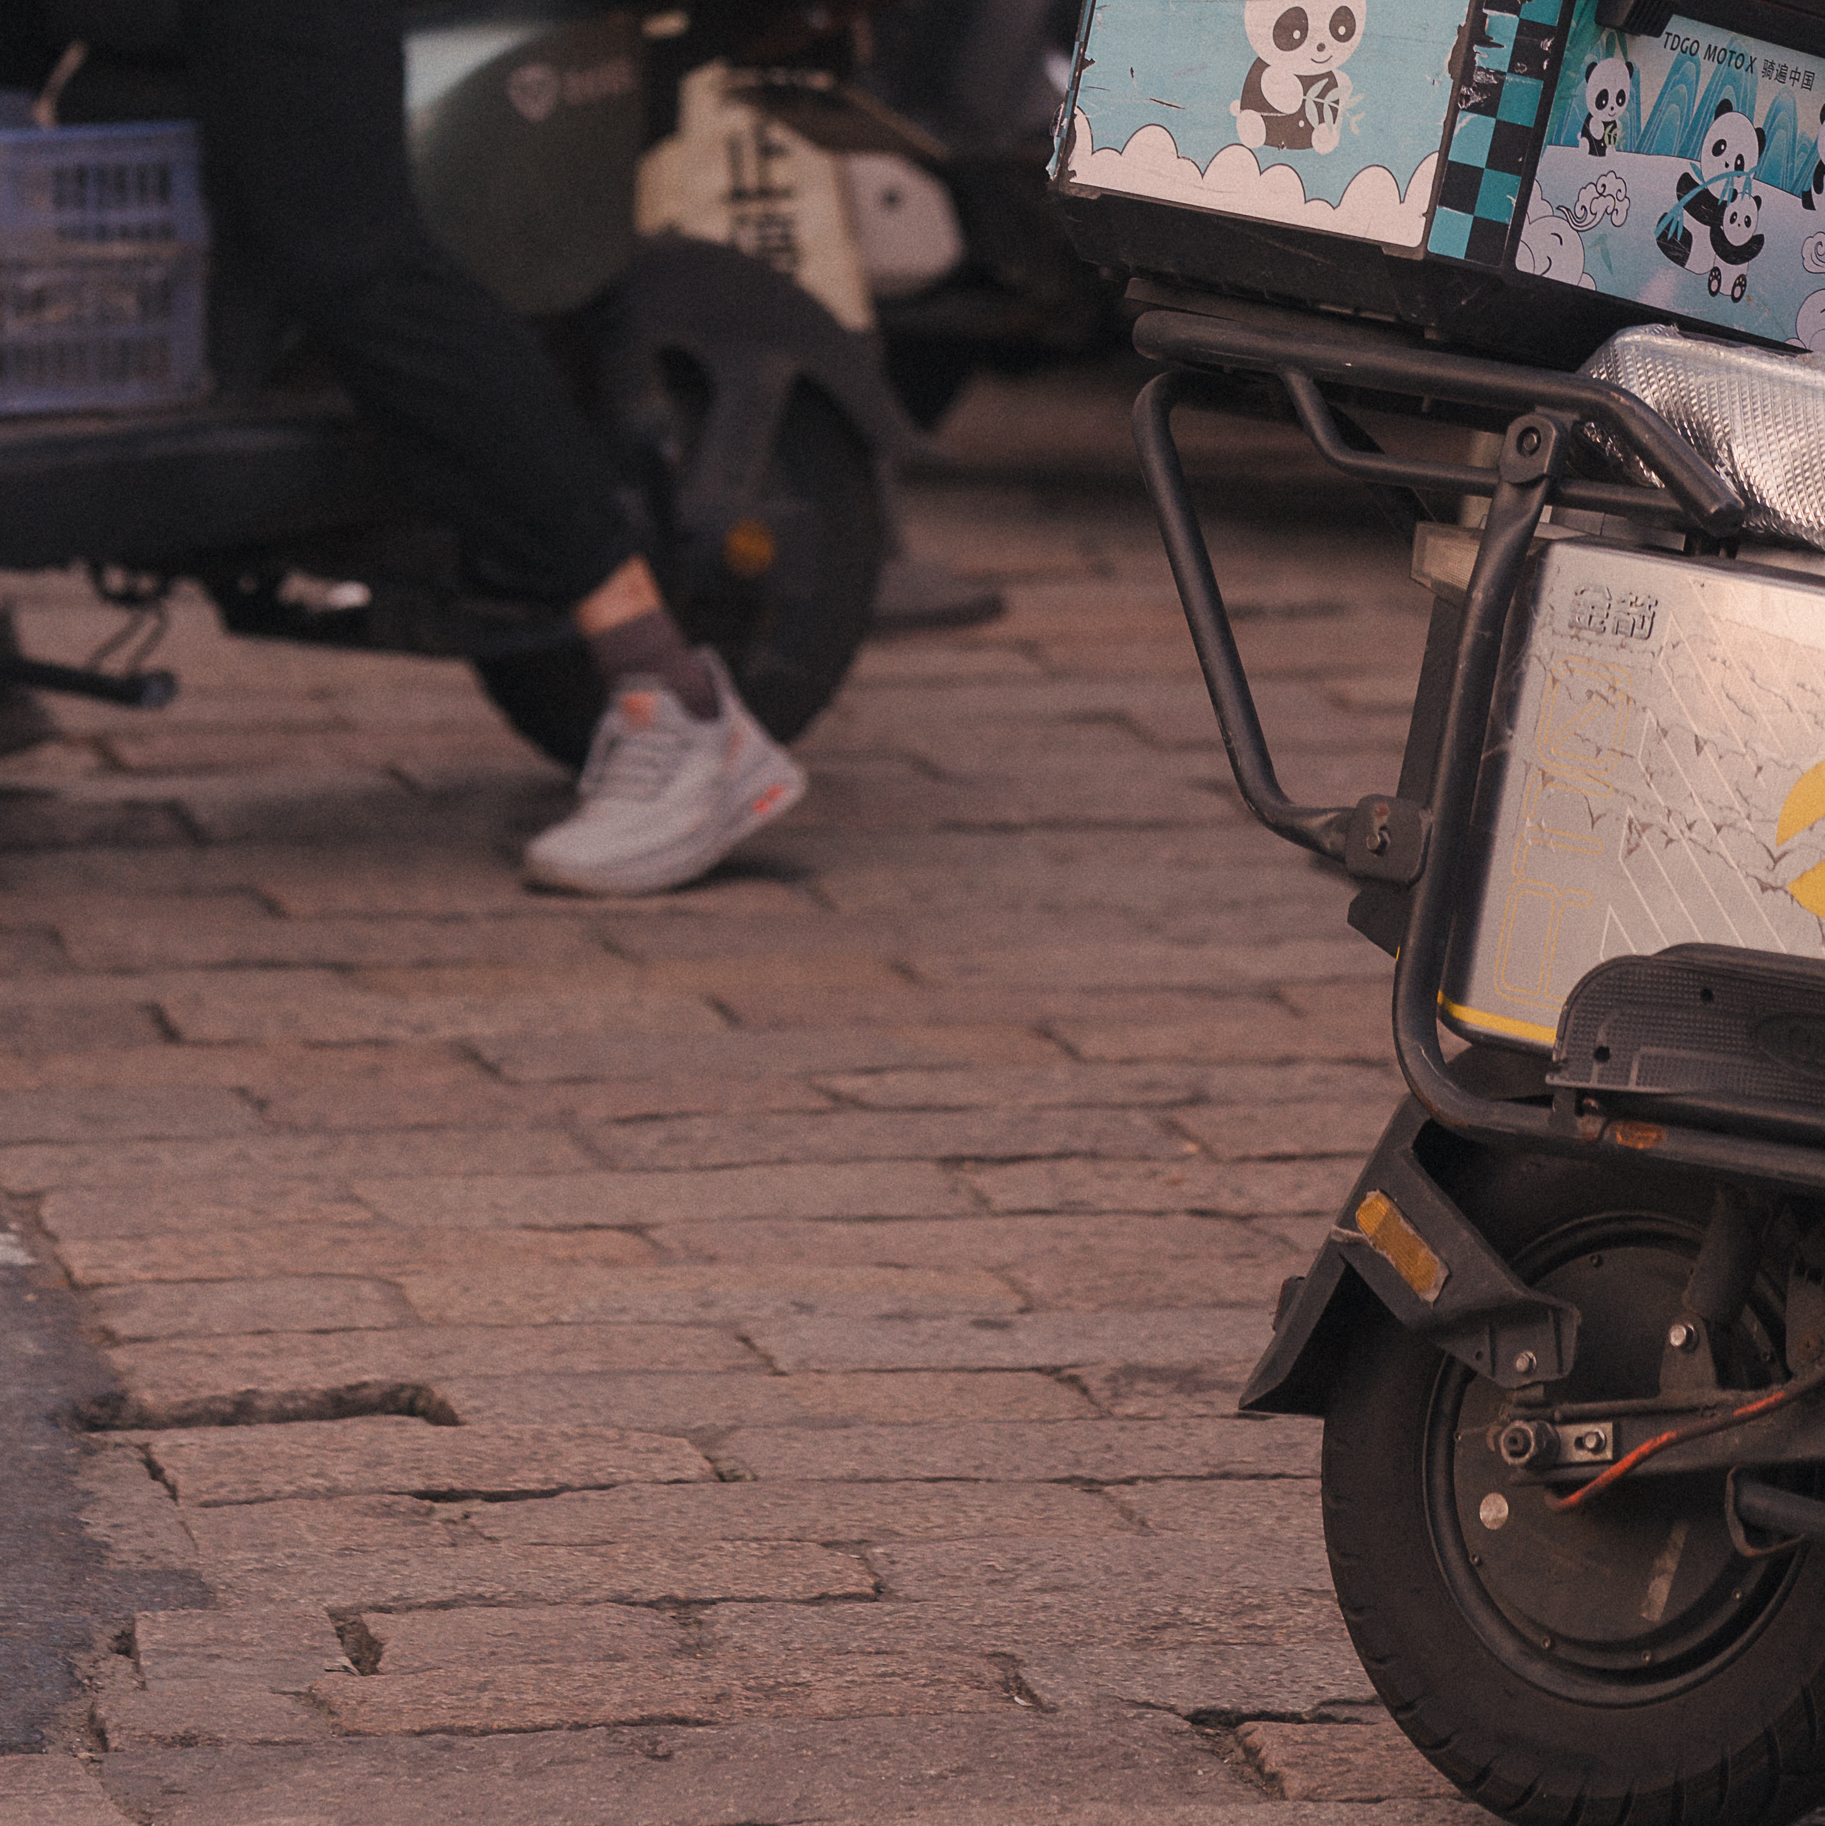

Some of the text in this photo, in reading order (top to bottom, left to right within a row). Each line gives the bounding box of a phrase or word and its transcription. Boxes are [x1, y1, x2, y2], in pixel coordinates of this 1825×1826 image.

[1663, 31, 1700, 57] TDGO
[1761, 58, 1816, 92] 骑遍中国
